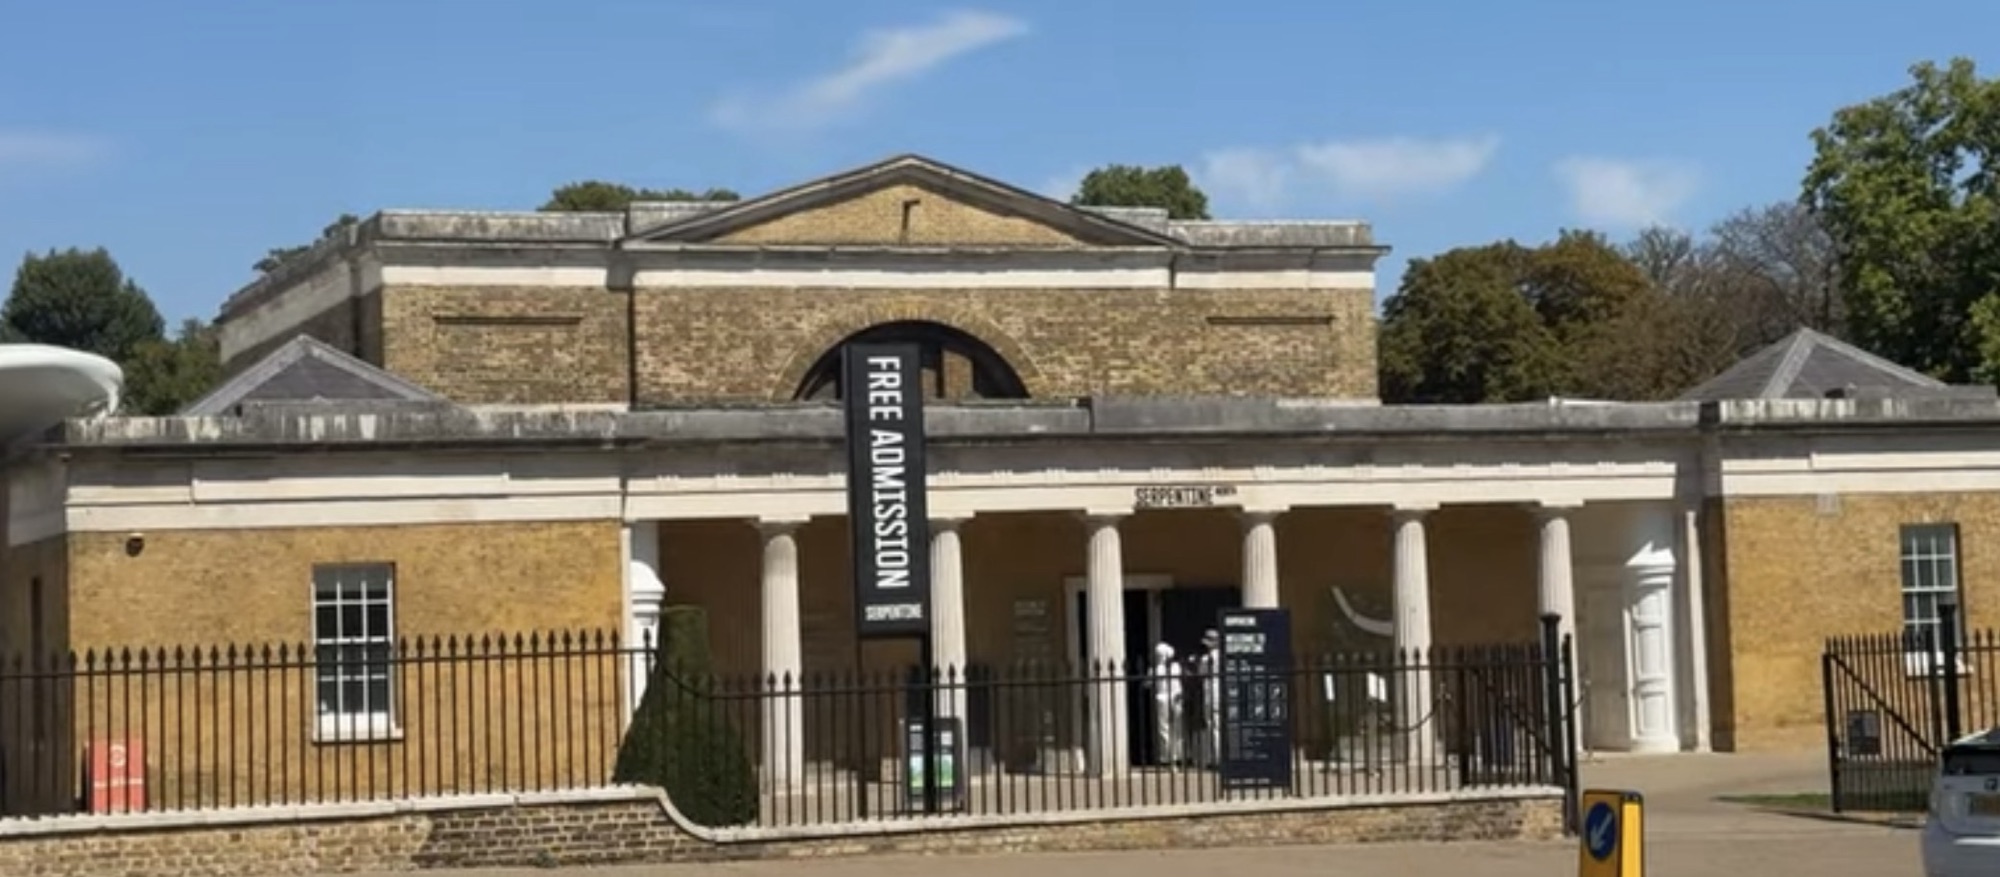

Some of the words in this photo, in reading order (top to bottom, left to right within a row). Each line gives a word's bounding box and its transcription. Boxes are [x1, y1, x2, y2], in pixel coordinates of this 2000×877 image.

[867, 356, 903, 420] FREE
[870, 430, 910, 588] ADMISSION
[1135, 487, 1214, 507] SERPENTINE
